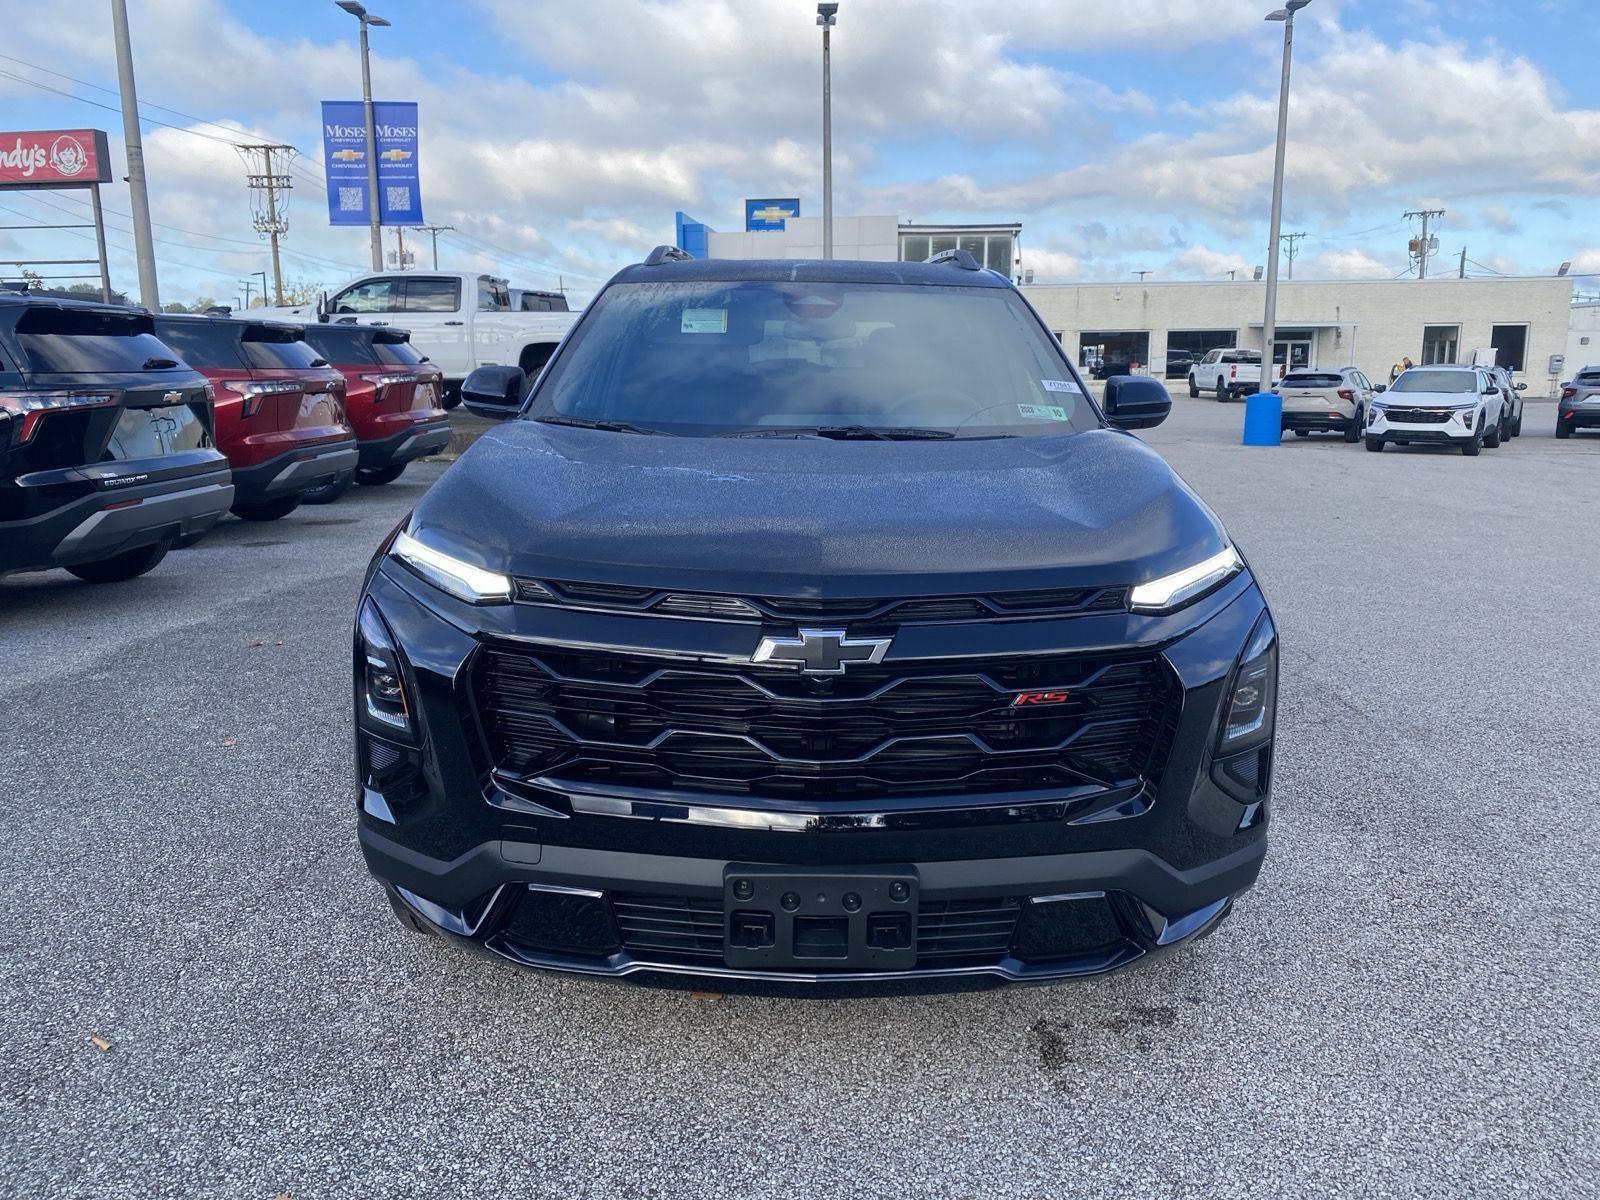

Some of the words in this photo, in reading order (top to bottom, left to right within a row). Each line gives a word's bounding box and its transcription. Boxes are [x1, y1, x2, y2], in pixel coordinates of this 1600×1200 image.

[376, 125, 416, 138] MOSES
[104, 477, 136, 486] EQUINOX
[1013, 691, 1070, 705] RS
